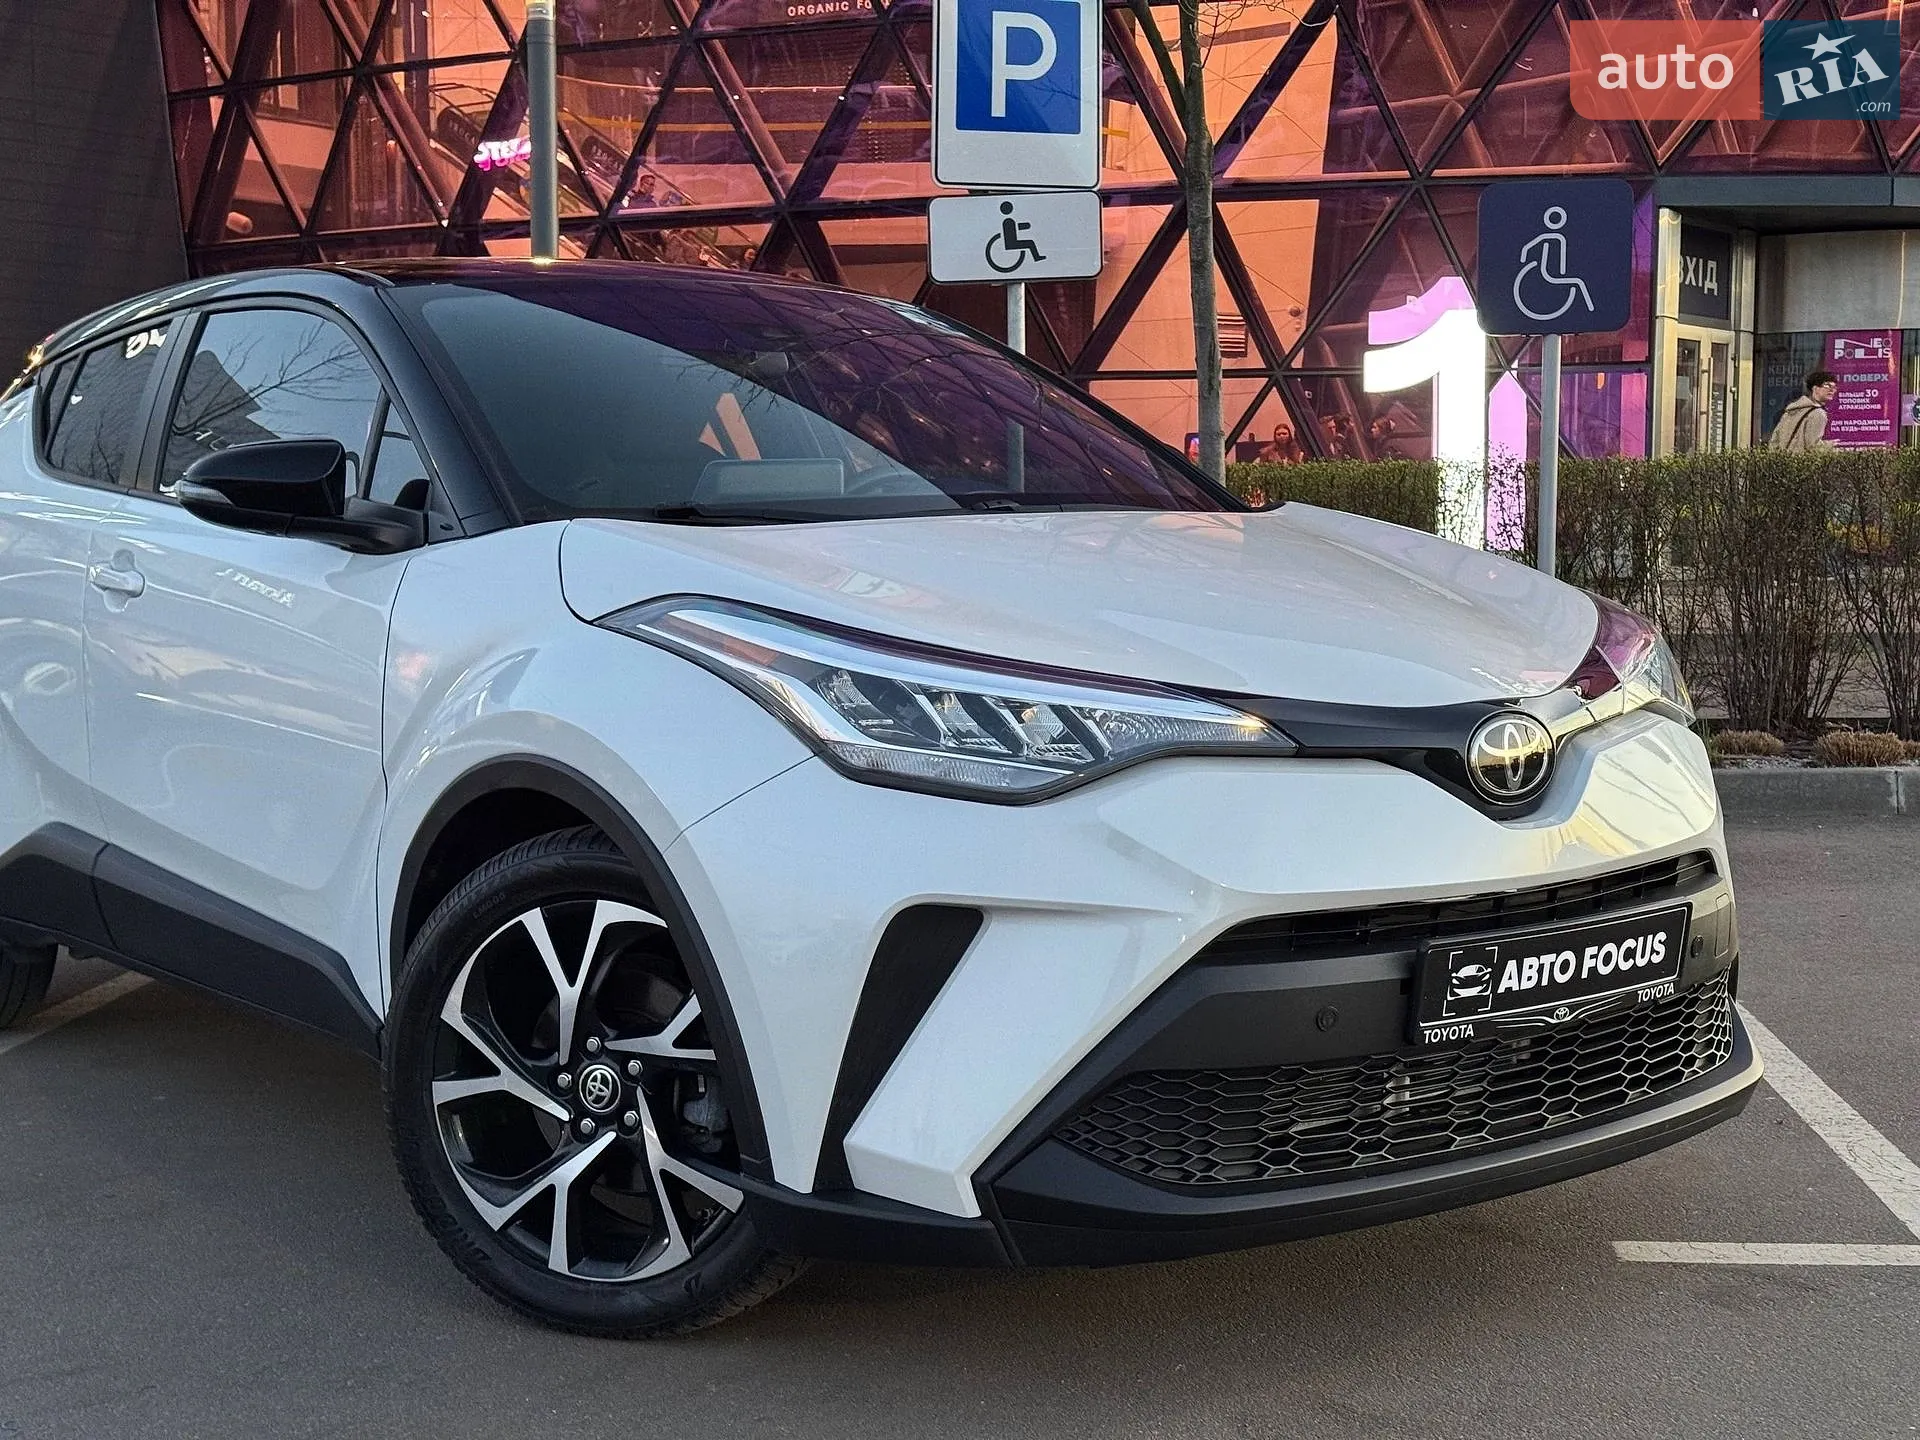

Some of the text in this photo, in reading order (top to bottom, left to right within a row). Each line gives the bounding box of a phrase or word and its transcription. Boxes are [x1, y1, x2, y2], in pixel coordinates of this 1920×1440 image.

[787, 1, 850, 17] ORGANIC
[991, 10, 1058, 118] P
[1843, 373, 1889, 382] ПОВЕРХ
[1865, 388, 1879, 398] 30
[1498, 931, 1668, 993] АВТО FOCUS
[1636, 981, 1675, 1004] TOYOTA
[1422, 1022, 1475, 1044] TOYOTA
